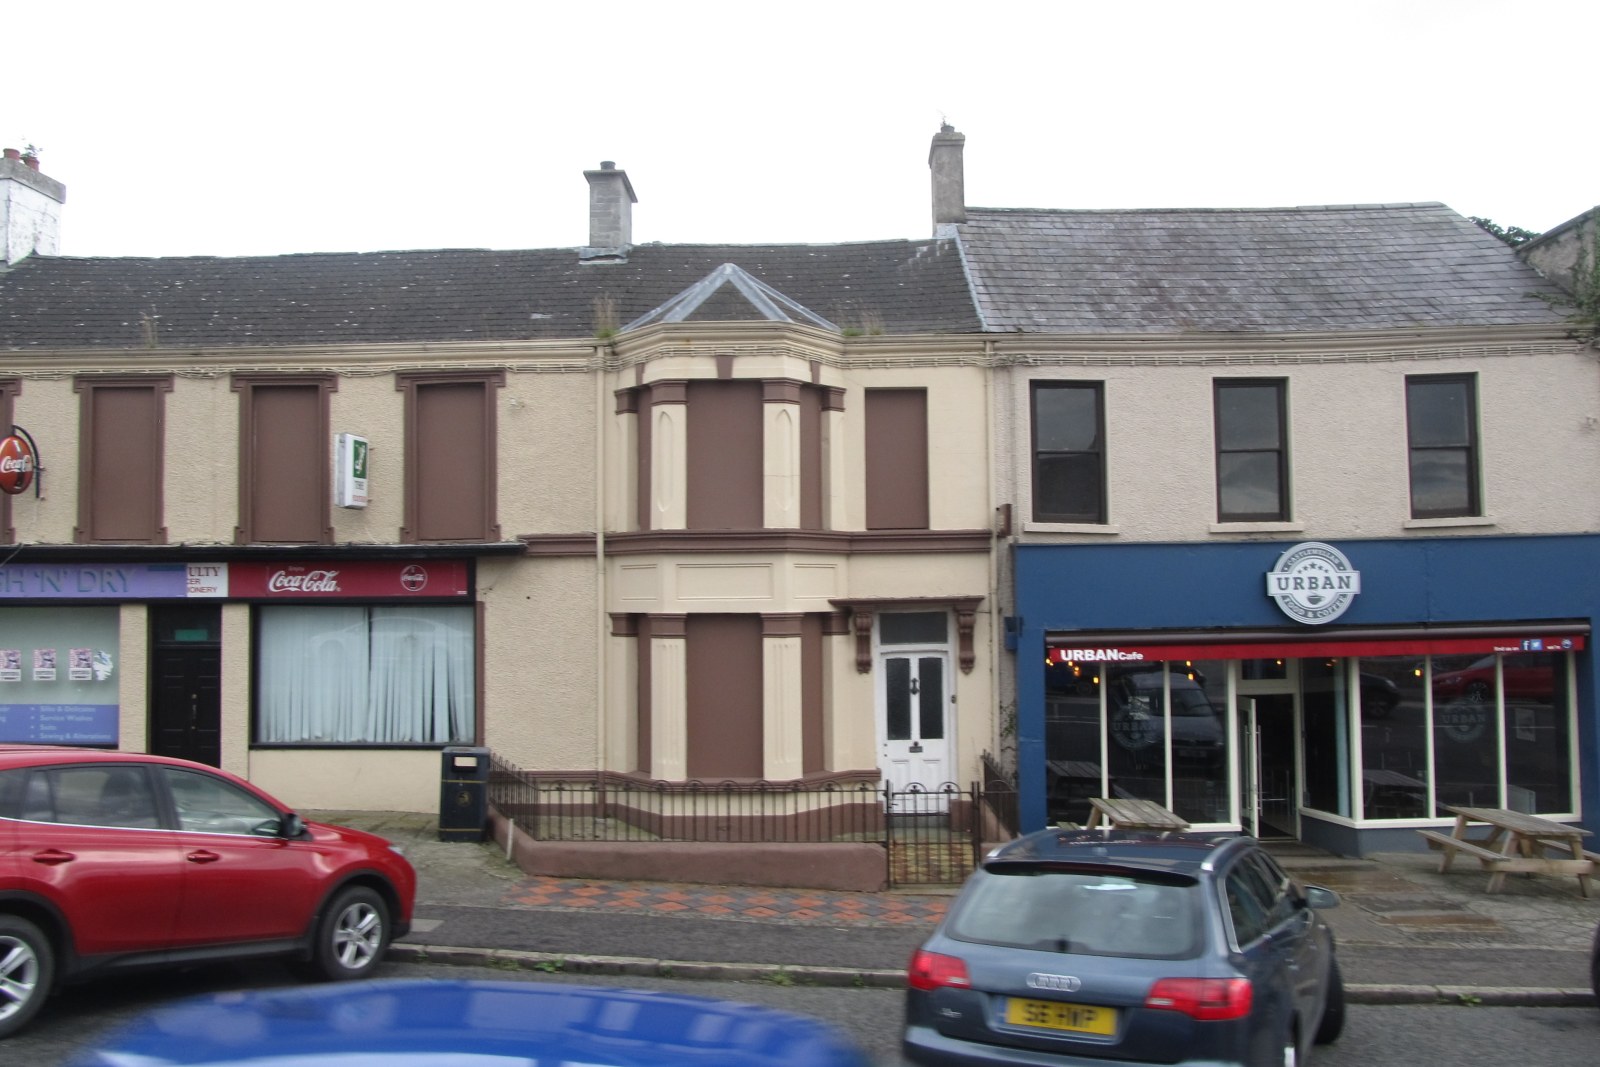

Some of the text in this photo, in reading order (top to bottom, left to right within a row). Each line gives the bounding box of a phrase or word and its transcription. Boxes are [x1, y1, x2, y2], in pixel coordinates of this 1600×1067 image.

[76, 568, 137, 593] DRY
[269, 570, 341, 592] Coca-Cola
[1276, 575, 1351, 590] URBAN
[1284, 598, 1305, 616] FOOD
[1317, 594, 1347, 617] COFFEE
